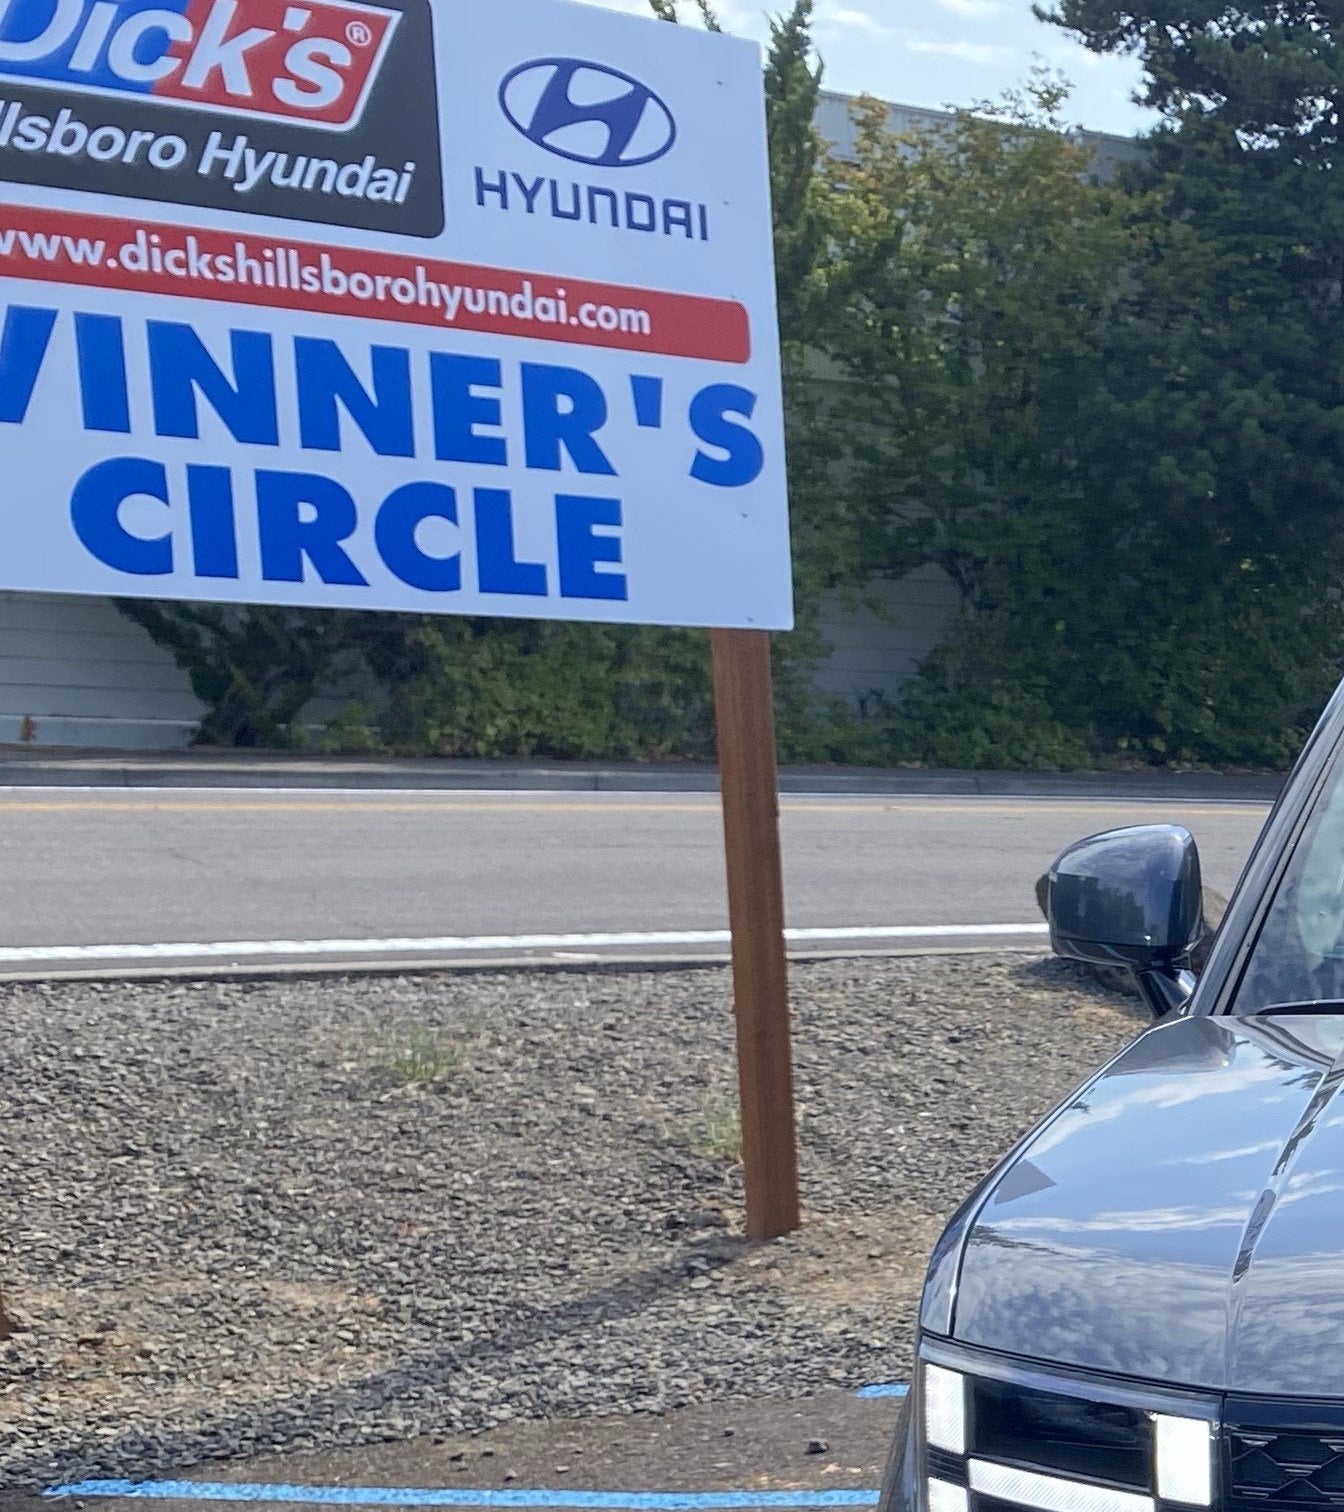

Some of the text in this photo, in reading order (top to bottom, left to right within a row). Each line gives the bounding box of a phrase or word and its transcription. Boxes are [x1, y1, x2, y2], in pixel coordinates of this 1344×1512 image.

[0, 100, 416, 205] lsboro Hyundai
[474, 166, 709, 241] HYUNDAI
[70, 456, 628, 601] CIRCLE
